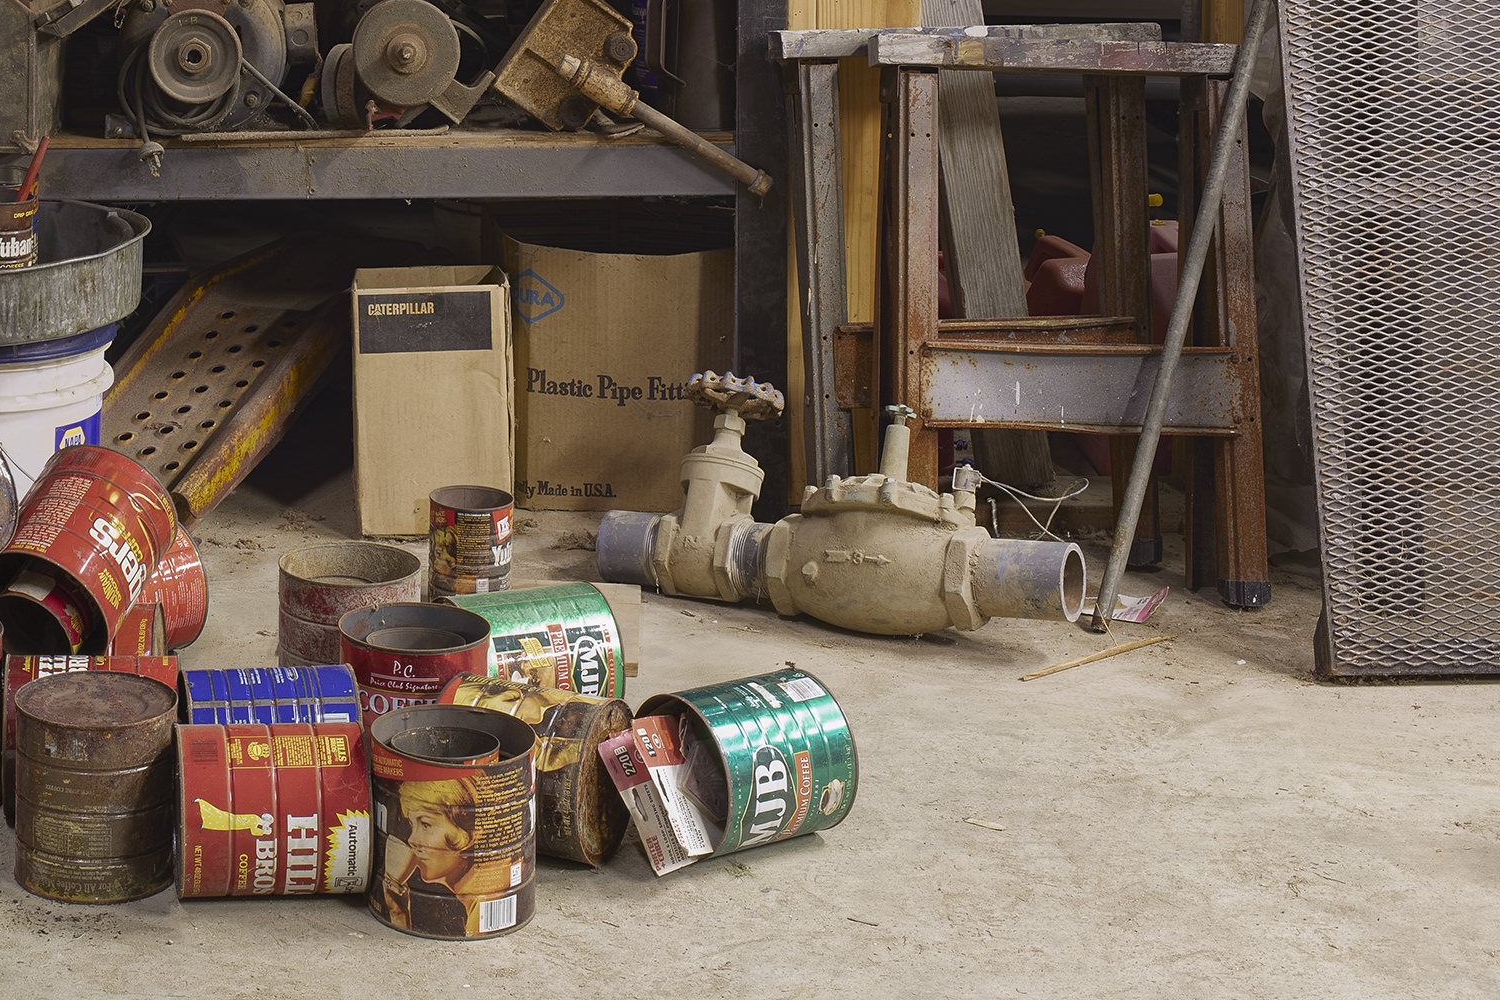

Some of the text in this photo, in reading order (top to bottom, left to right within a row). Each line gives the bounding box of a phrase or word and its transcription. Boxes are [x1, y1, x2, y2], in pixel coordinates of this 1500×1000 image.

[367, 302, 435, 316] CATERPILLAR
[514, 290, 555, 307] URA
[526, 367, 688, 406] Plastic Pipe Fitti
[537, 481, 616, 498] Made in U.S.A.
[98, 572, 119, 610] MOUNTAIN
[104, 568, 122, 602] GROWN
[551, 630, 569, 678] PREMIUM
[392, 660, 416, 678] P.C.
[370, 677, 439, 692] Price Club Signature
[338, 737, 347, 762] HILLS
[378, 757, 403, 768] AUTOMATIC
[383, 766, 404, 777] MAKERS
[618, 752, 636, 777] 220
[738, 759, 789, 849] MJB
[781, 756, 812, 841] PREMIUM COFFEE
[347, 824, 358, 876] Automatic
[646, 837, 661, 872] PORTER
[237, 853, 249, 890] COFFEE
